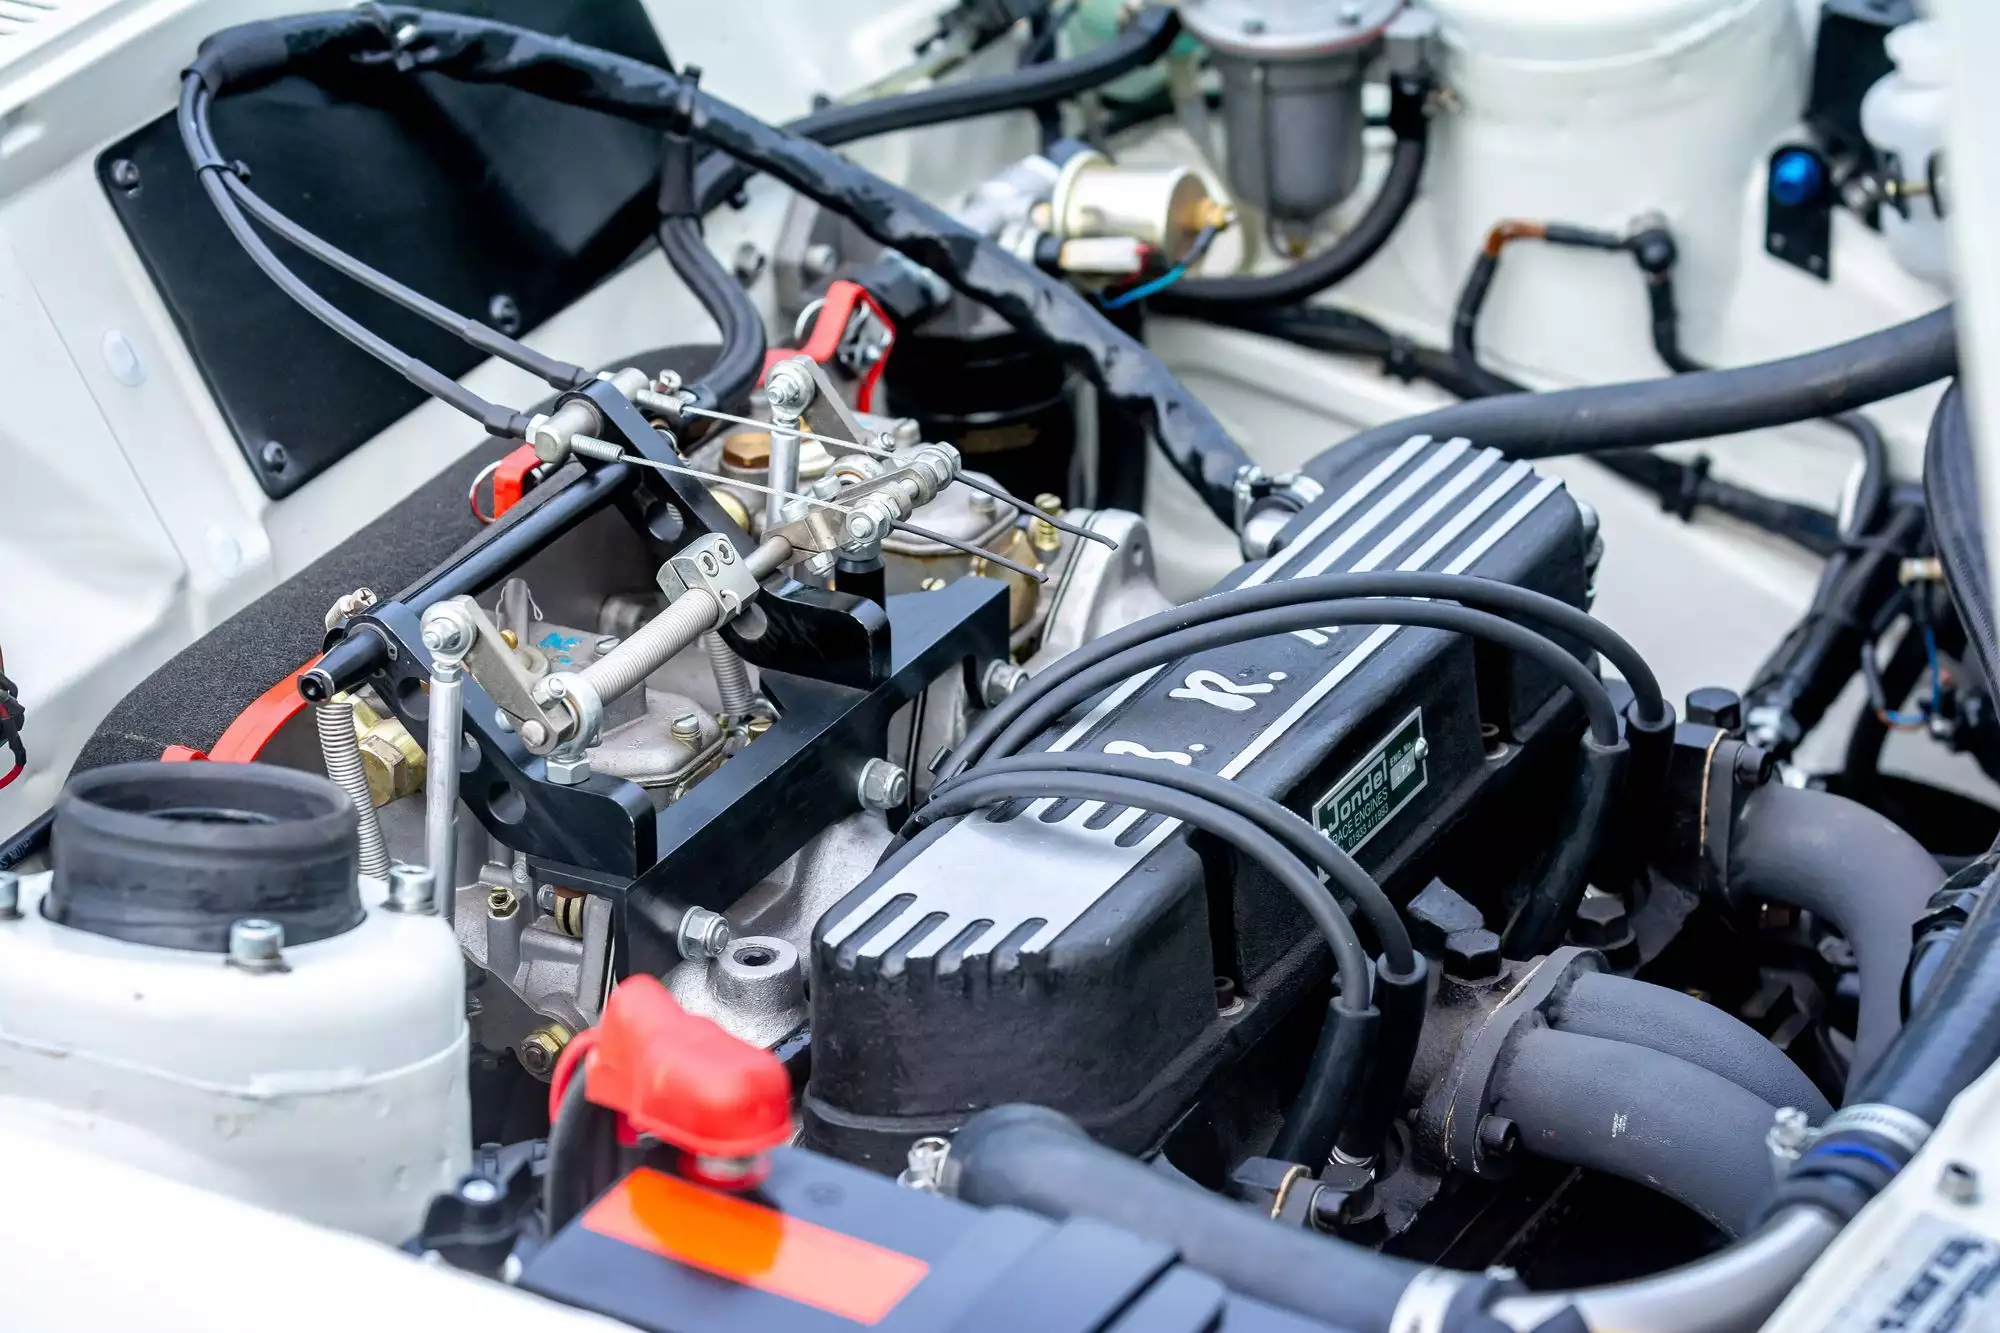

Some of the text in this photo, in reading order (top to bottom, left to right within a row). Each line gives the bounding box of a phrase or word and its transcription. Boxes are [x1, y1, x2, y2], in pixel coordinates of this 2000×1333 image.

[1327, 752, 1388, 832] Jondel
[1354, 787, 1388, 827] ENGINES
[1348, 803, 1389, 847] 01933 411993
